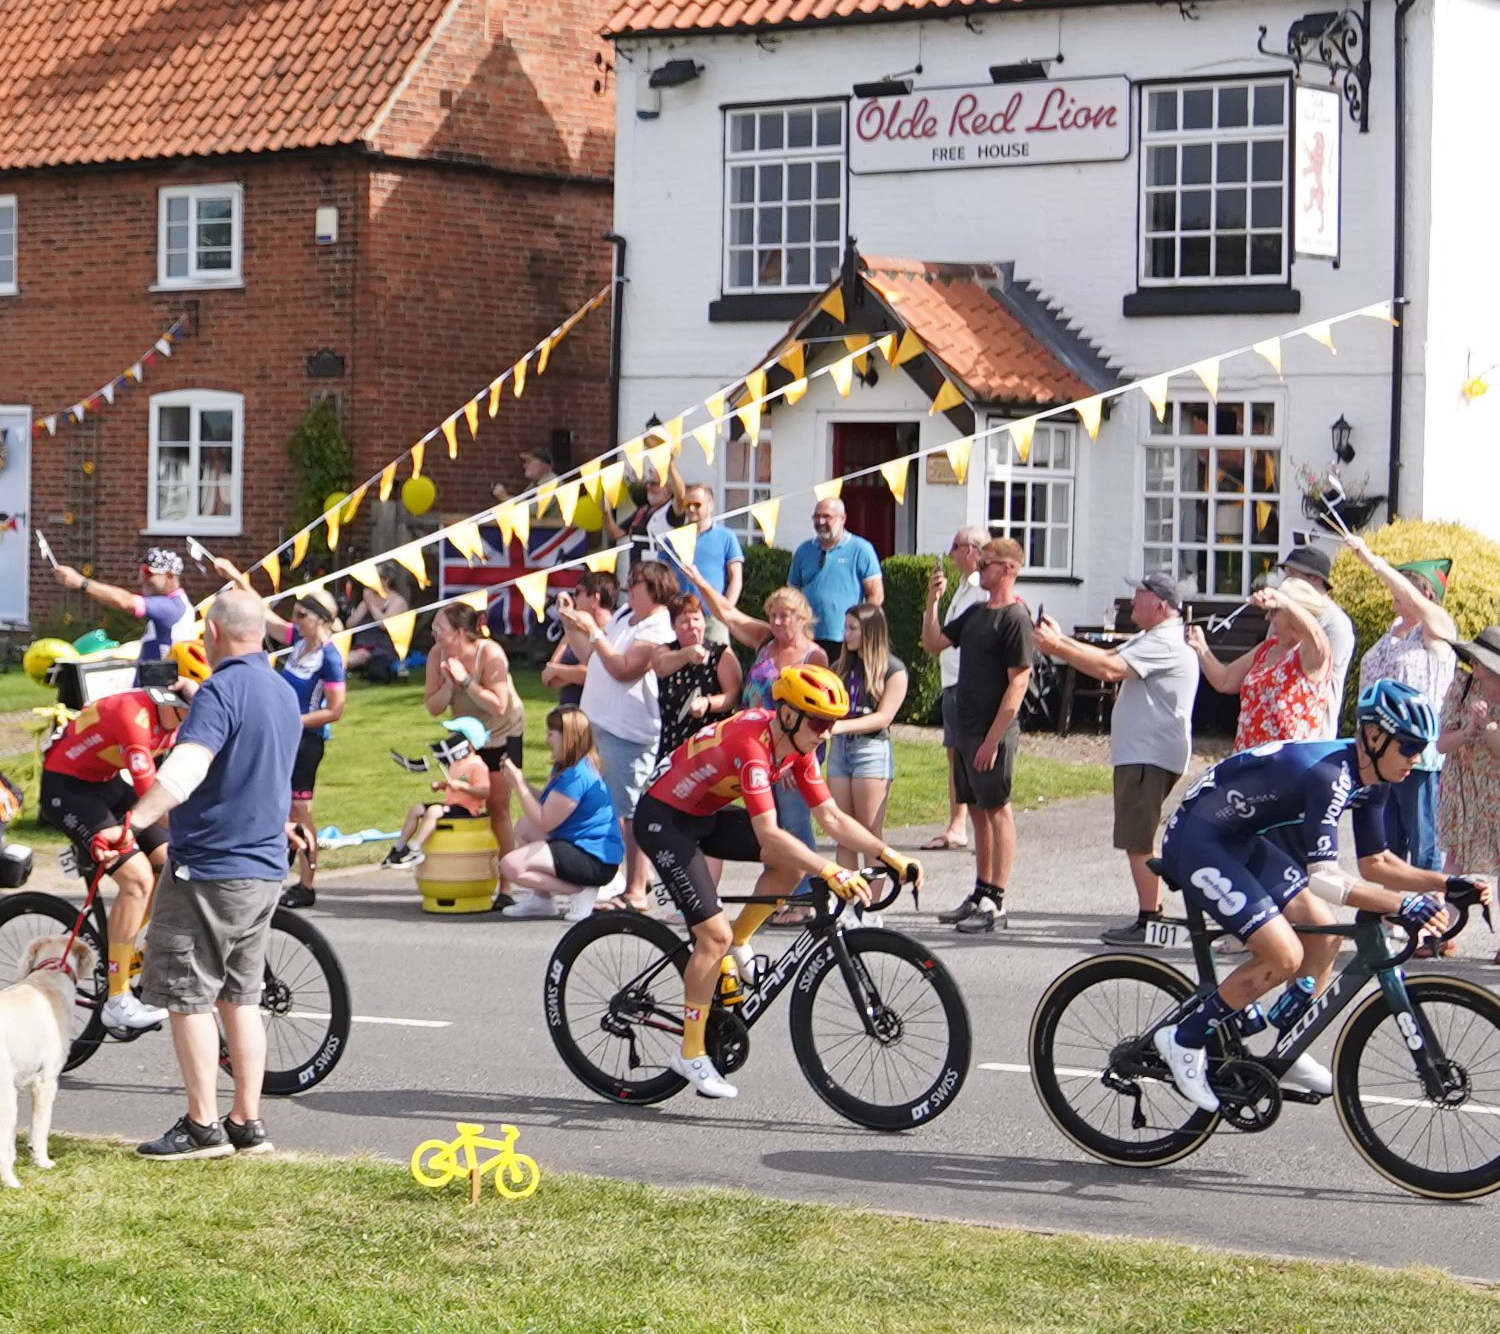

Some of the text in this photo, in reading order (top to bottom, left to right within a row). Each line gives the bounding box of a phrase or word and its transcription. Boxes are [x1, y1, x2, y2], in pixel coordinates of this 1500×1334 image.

[856, 87, 1118, 143] Olde Red Lion
[932, 142, 1030, 162] FREE HOUSE
[1150, 923, 1178, 946] 101
[547, 958, 564, 1027] DT SWISS
[741, 928, 815, 1022] DARE
[798, 955, 827, 994] SWISS
[1277, 973, 1346, 1059] SCOTT
[298, 1033, 340, 1085] DT SWISS
[911, 1068, 959, 1122] DT SWISS
